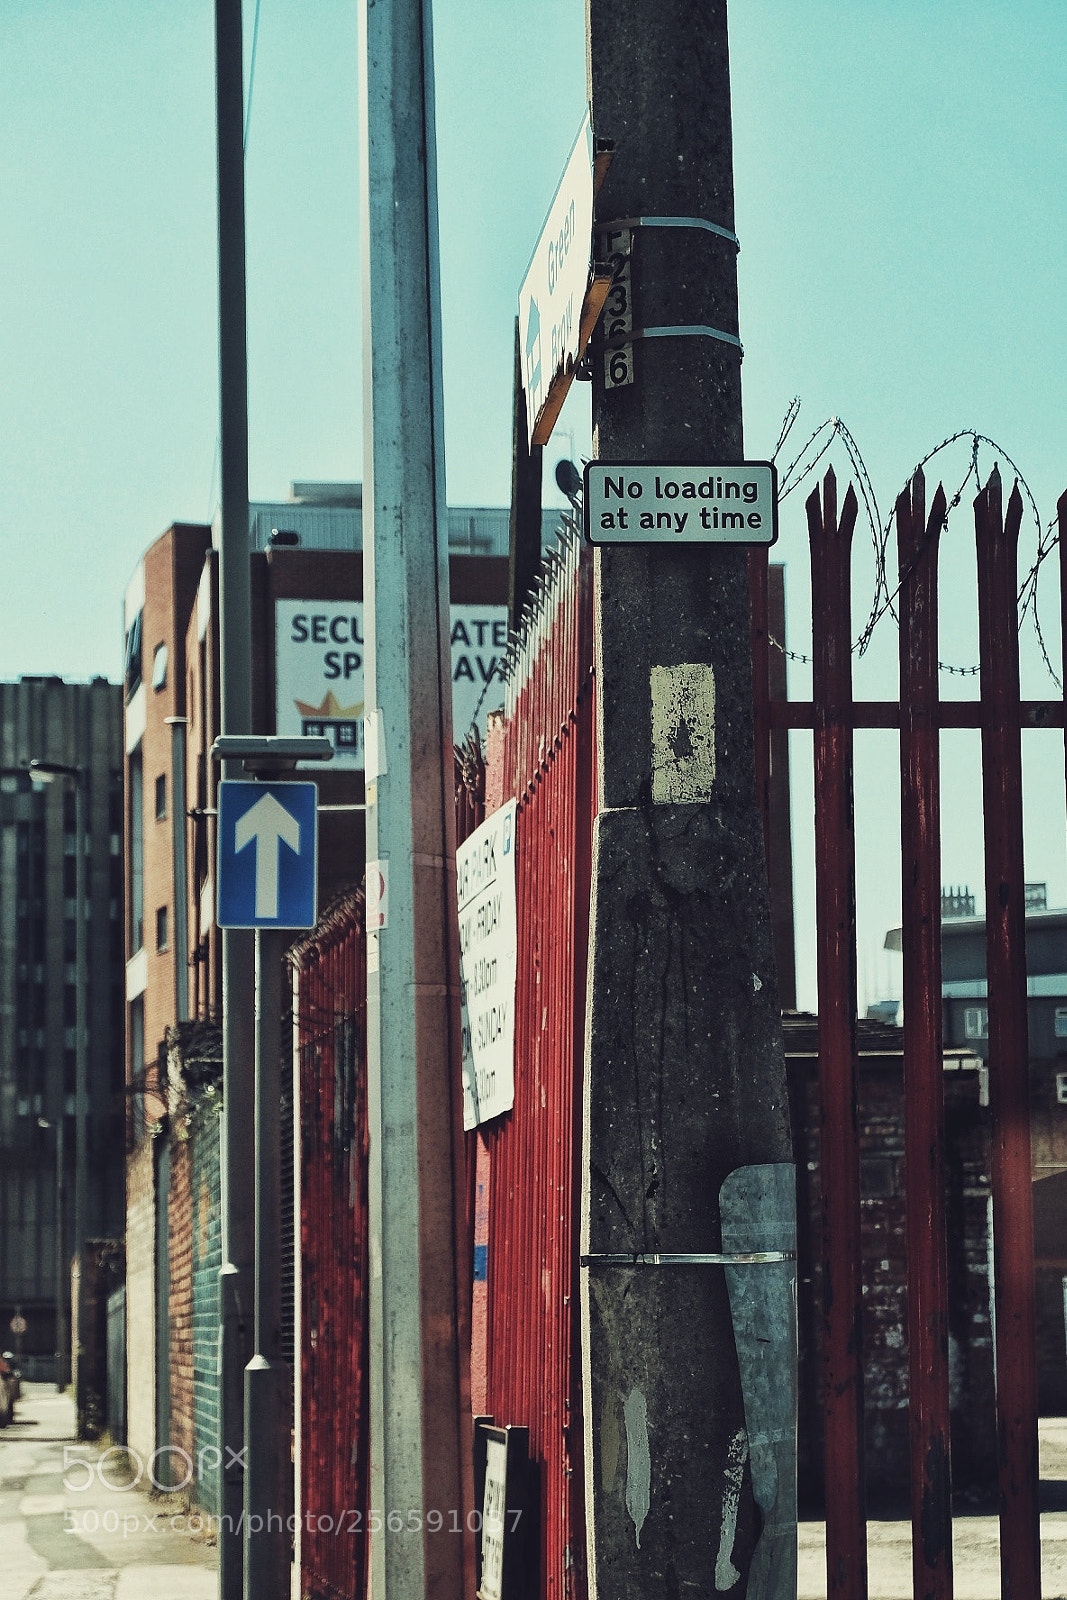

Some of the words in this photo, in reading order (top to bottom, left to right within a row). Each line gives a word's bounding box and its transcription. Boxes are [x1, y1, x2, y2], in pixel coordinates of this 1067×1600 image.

[547, 198, 575, 296] Green
[603, 476, 643, 499] No
[655, 476, 759, 504] loading
[600, 508, 628, 529] at
[639, 511, 687, 533] any
[699, 507, 762, 529] time
[290, 614, 364, 644] SECU
[451, 619, 507, 648] ATE
[323, 651, 364, 680] SP
[476, 891, 503, 944] FRIDAY
[478, 1000, 508, 1052] SUNDAY
